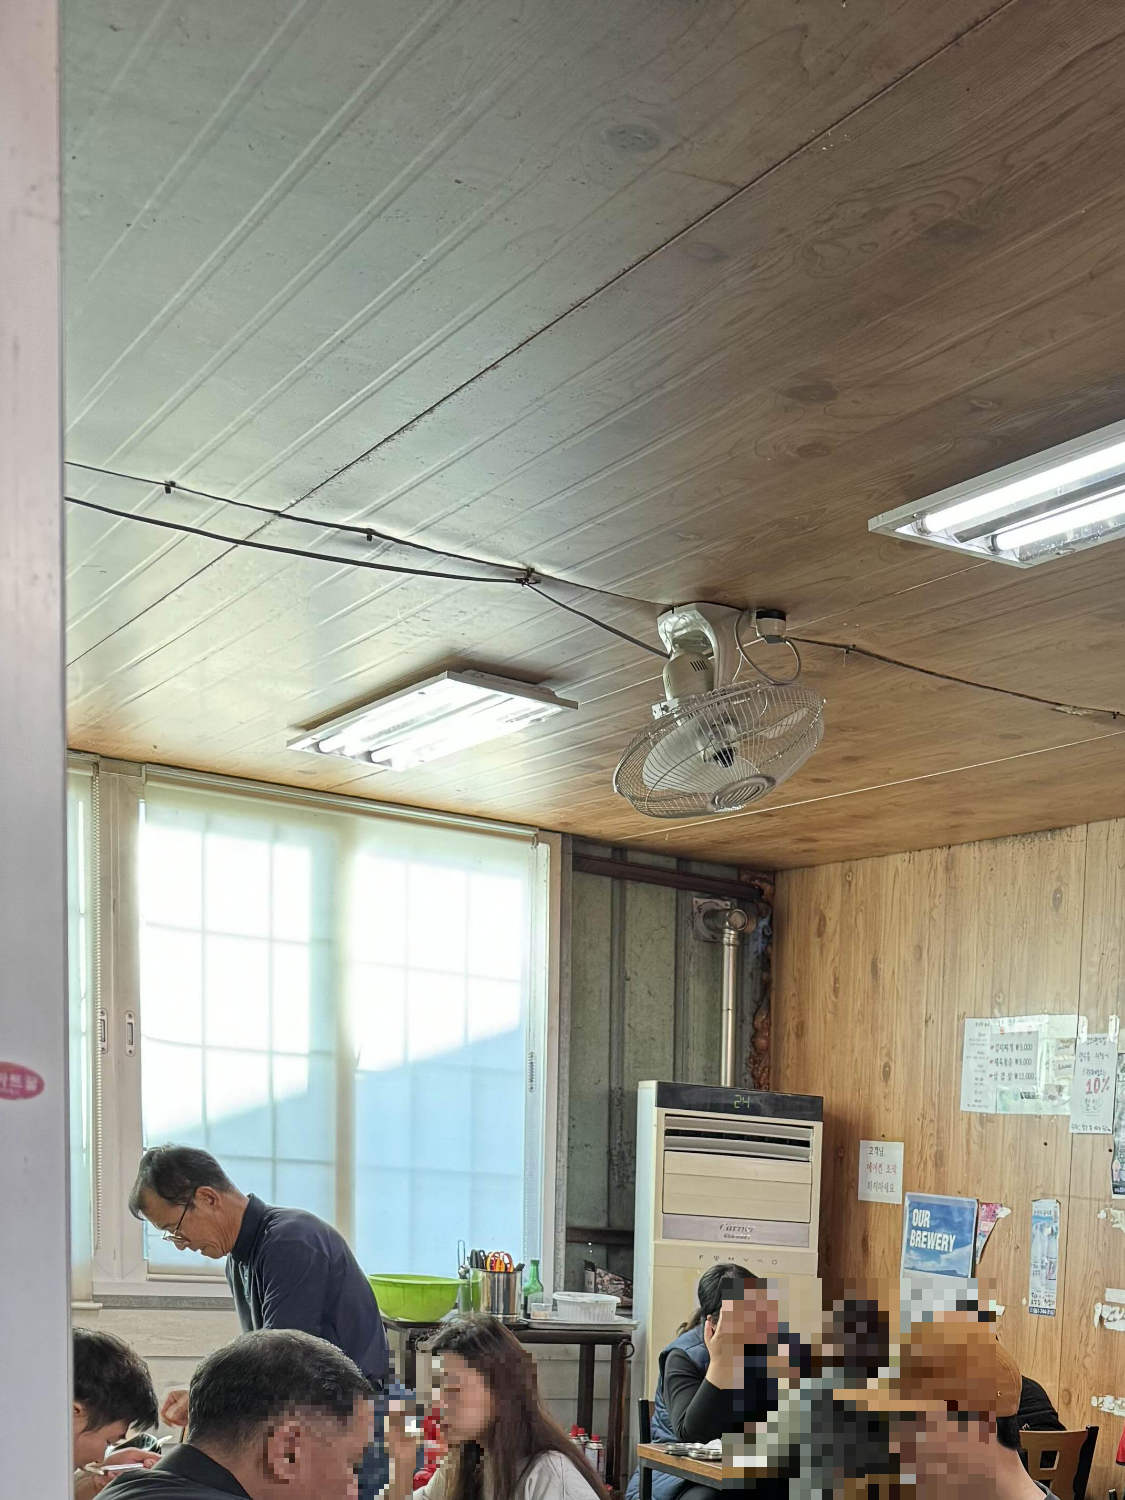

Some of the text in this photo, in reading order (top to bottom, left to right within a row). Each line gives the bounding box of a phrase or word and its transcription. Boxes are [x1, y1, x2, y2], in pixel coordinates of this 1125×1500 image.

[1086, 1076, 1110, 1095] 10%
[734, 1094, 750, 1109] 24
[912, 1208, 931, 1228] OUR
[909, 1229, 956, 1252] BREWERY
